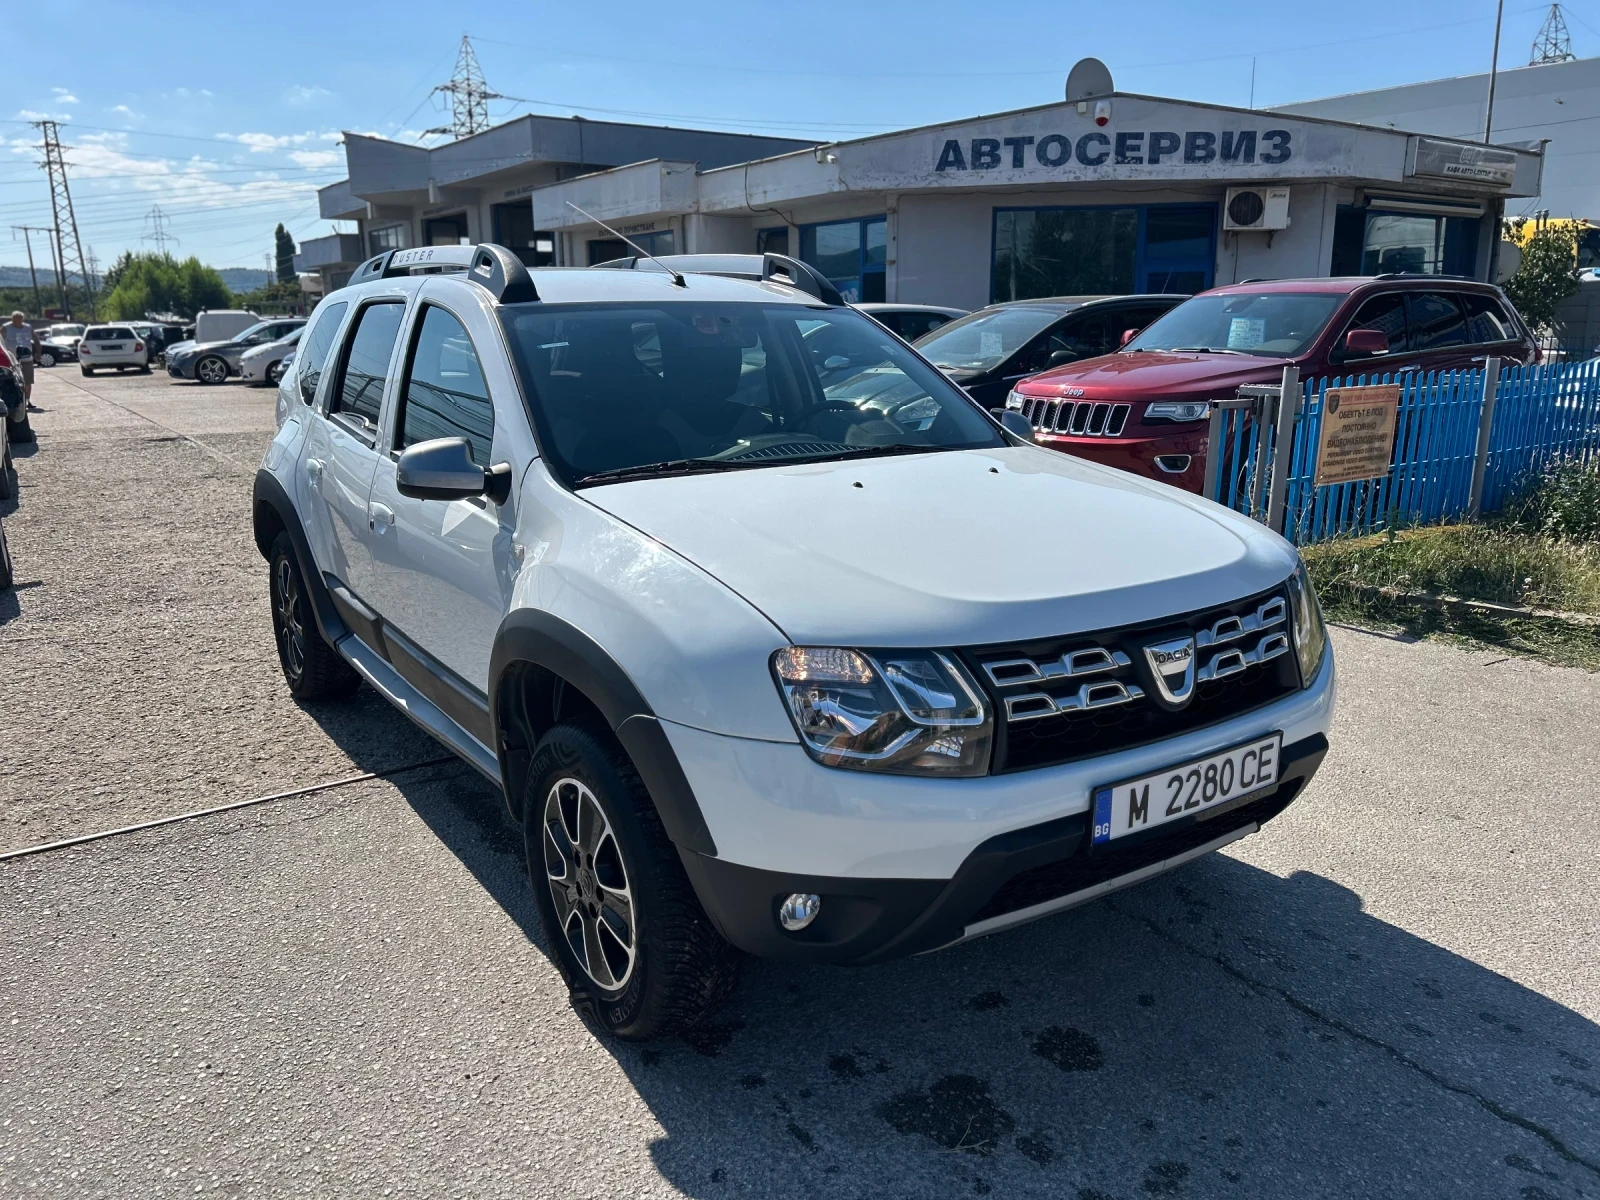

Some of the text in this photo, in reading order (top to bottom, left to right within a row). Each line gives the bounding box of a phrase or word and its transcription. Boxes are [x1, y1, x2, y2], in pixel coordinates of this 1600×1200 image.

[934, 129, 1293, 172] АВТОСЕРВИЗ
[392, 249, 434, 264] DUSTER
[1063, 386, 1084, 397] Jeep
[1339, 409, 1365, 419] ОБЕКТЪТ
[1371, 408, 1383, 417] ПОД
[1342, 422, 1376, 433] ПОСТОЯННО
[1157, 649, 1191, 663] DACIA
[1128, 743, 1275, 829] M 2280 CE
[1094, 822, 1110, 838] BG
